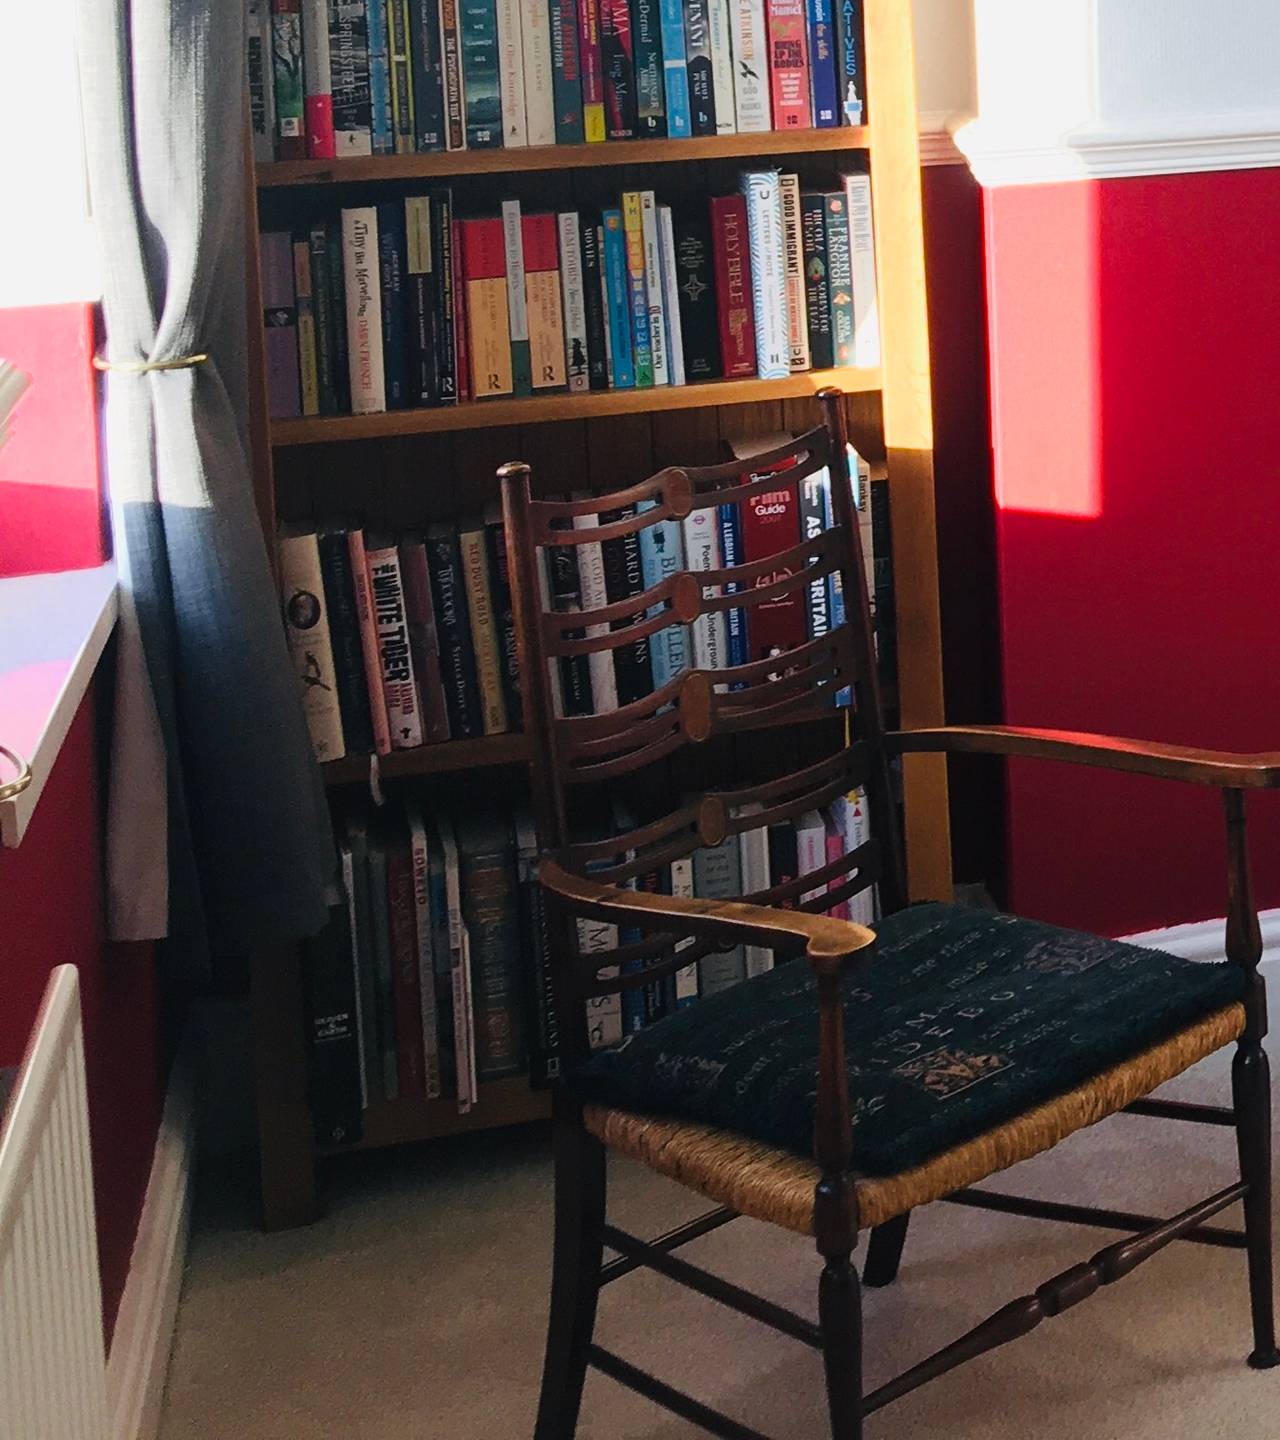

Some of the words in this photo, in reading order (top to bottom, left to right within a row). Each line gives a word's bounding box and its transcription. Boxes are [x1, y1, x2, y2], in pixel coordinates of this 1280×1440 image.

[339, 16, 356, 94] SPRINGSTEEN
[739, 7, 754, 61] ATKINSON
[762, 209, 772, 245] LETTERS
[783, 193, 796, 218] GOOD
[723, 213, 740, 254] HOLY
[785, 220, 801, 274] IMMIGRANT
[765, 254, 774, 278] NOTE
[827, 227, 842, 288] LANGTON
[835, 226, 850, 287] FRANNIE
[728, 259, 744, 304] BIBLE
[352, 224, 369, 248] Tiny
[361, 350, 372, 390] FRENCH
[646, 305, 661, 317] 10
[648, 317, 660, 325] in
[650, 354, 664, 369] One
[754, 503, 786, 516] Guide
[857, 475, 869, 513] Banksy
[372, 574, 403, 625] WHITE
[471, 567, 487, 594] DUST
[474, 596, 489, 626] ROAD
[378, 625, 411, 683] TIGER
[703, 613, 720, 670] Undergroun
[414, 847, 427, 906] SOWETO
